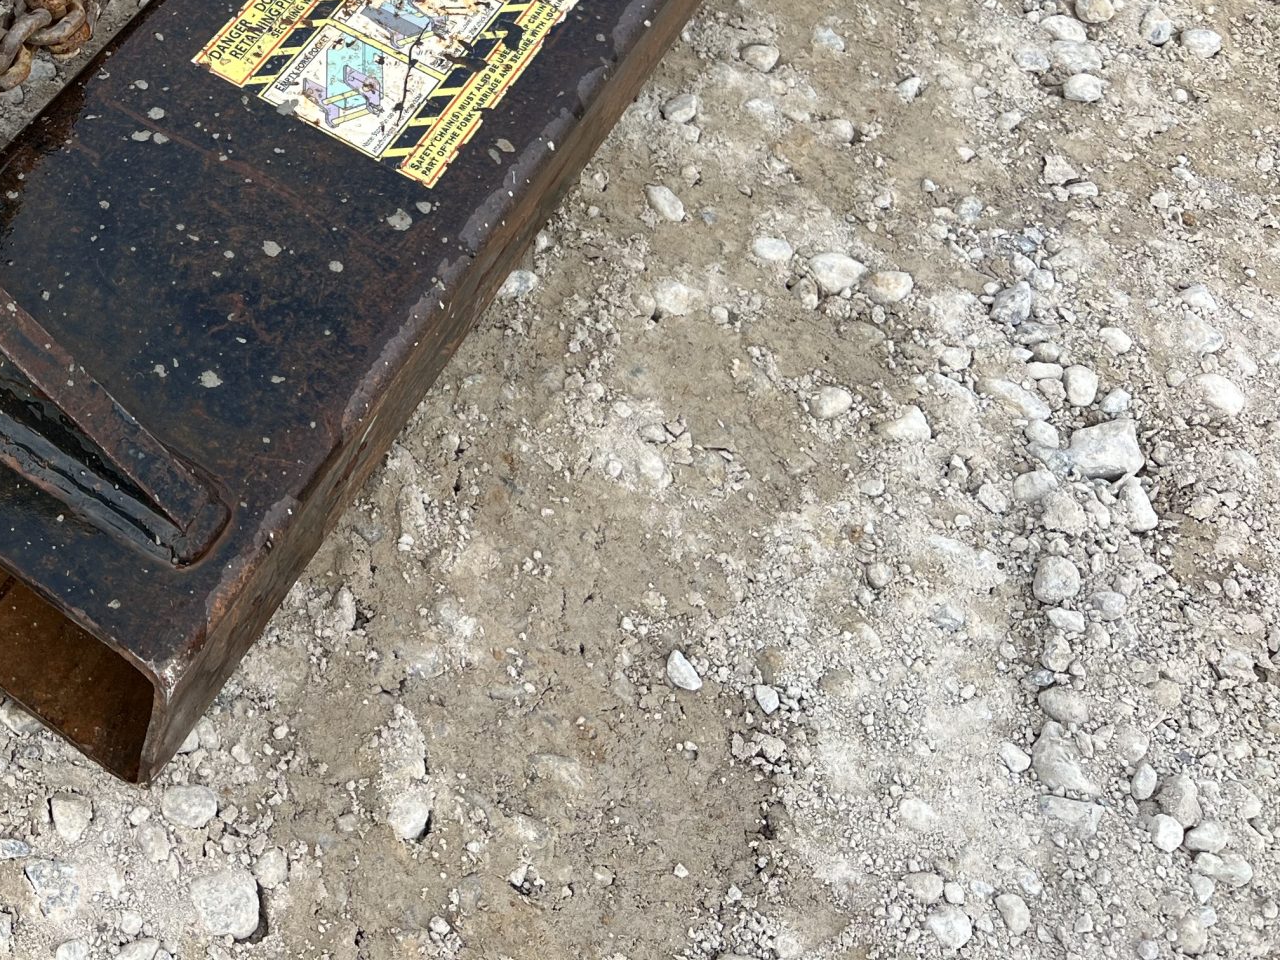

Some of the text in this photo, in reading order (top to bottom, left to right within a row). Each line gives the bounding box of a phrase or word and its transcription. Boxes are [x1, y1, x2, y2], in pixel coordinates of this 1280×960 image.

[206, 16, 254, 61] DANGER
[268, 2, 306, 39] SECRING
[272, 32, 331, 93] EMPTY FORK POCKET
[408, 140, 438, 171] SAFETY
[430, 109, 464, 143] CHAIN(S)
[456, 90, 478, 112] MUST
[471, 72, 493, 92] ALSO
[487, 62, 501, 74] BE
[495, 45, 513, 64] USE
[526, 2, 548, 25] CHAIN
[419, 155, 441, 177] PART
[434, 144, 449, 157] OF
[443, 129, 461, 146] THE
[454, 110, 476, 132] FORK
[469, 76, 503, 112] CARRIAGE
[497, 61, 513, 79] AND
[508, 36, 534, 64] SECURE
[528, 19, 547, 39] WITH
